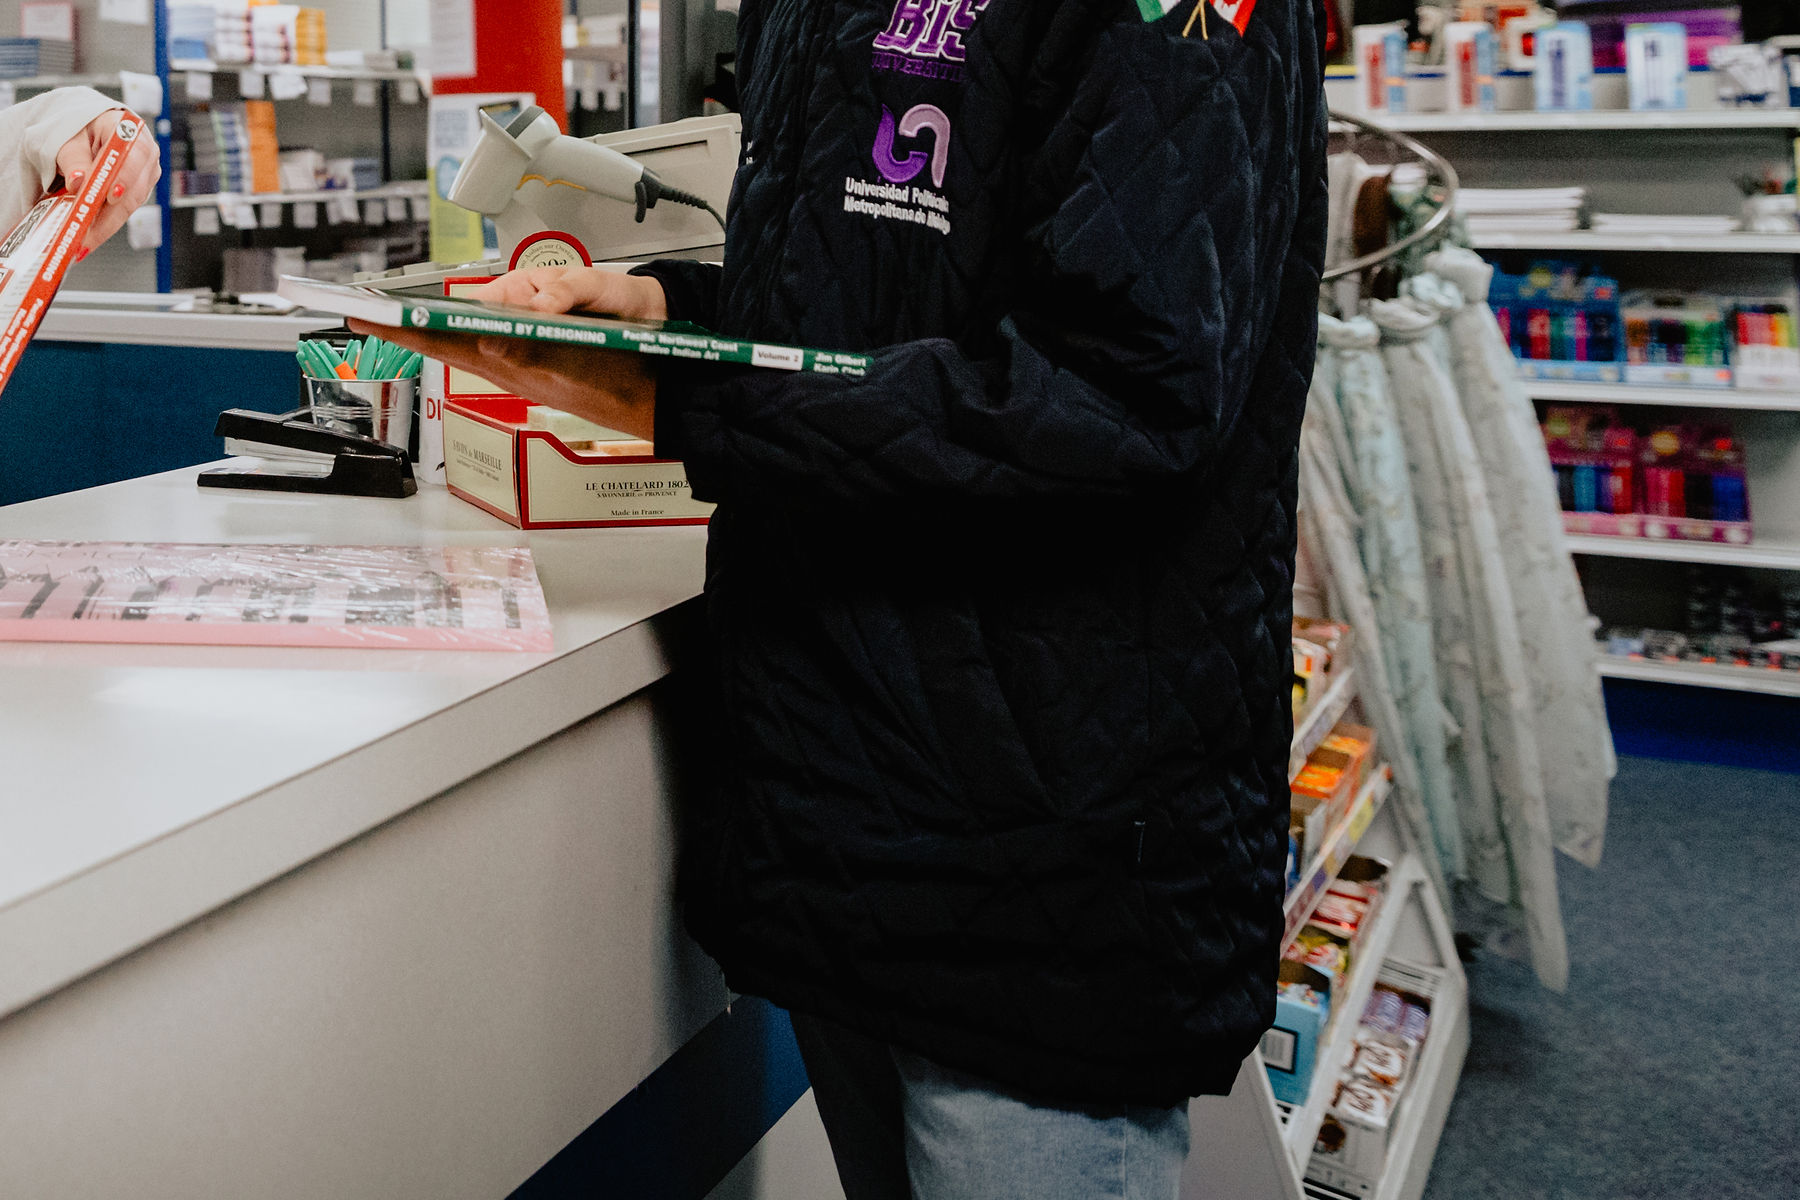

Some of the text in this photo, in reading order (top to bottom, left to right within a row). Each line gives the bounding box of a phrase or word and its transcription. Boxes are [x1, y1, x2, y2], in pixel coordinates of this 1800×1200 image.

[845, 176, 909, 203] Universidad
[42, 149, 120, 282] LEARNING BY DESIGNING
[844, 195, 915, 221] Metropolitana
[447, 314, 607, 345] LEARNING BY DESIGNING
[622, 329, 738, 352] Pacific Northwest Coast
[639, 343, 720, 361] Native Indian Art
[757, 351, 800, 363] Volume 2
[472, 448, 502, 471] MARSEILLE
[585, 480, 689, 491] LE CHATELARD 1802
